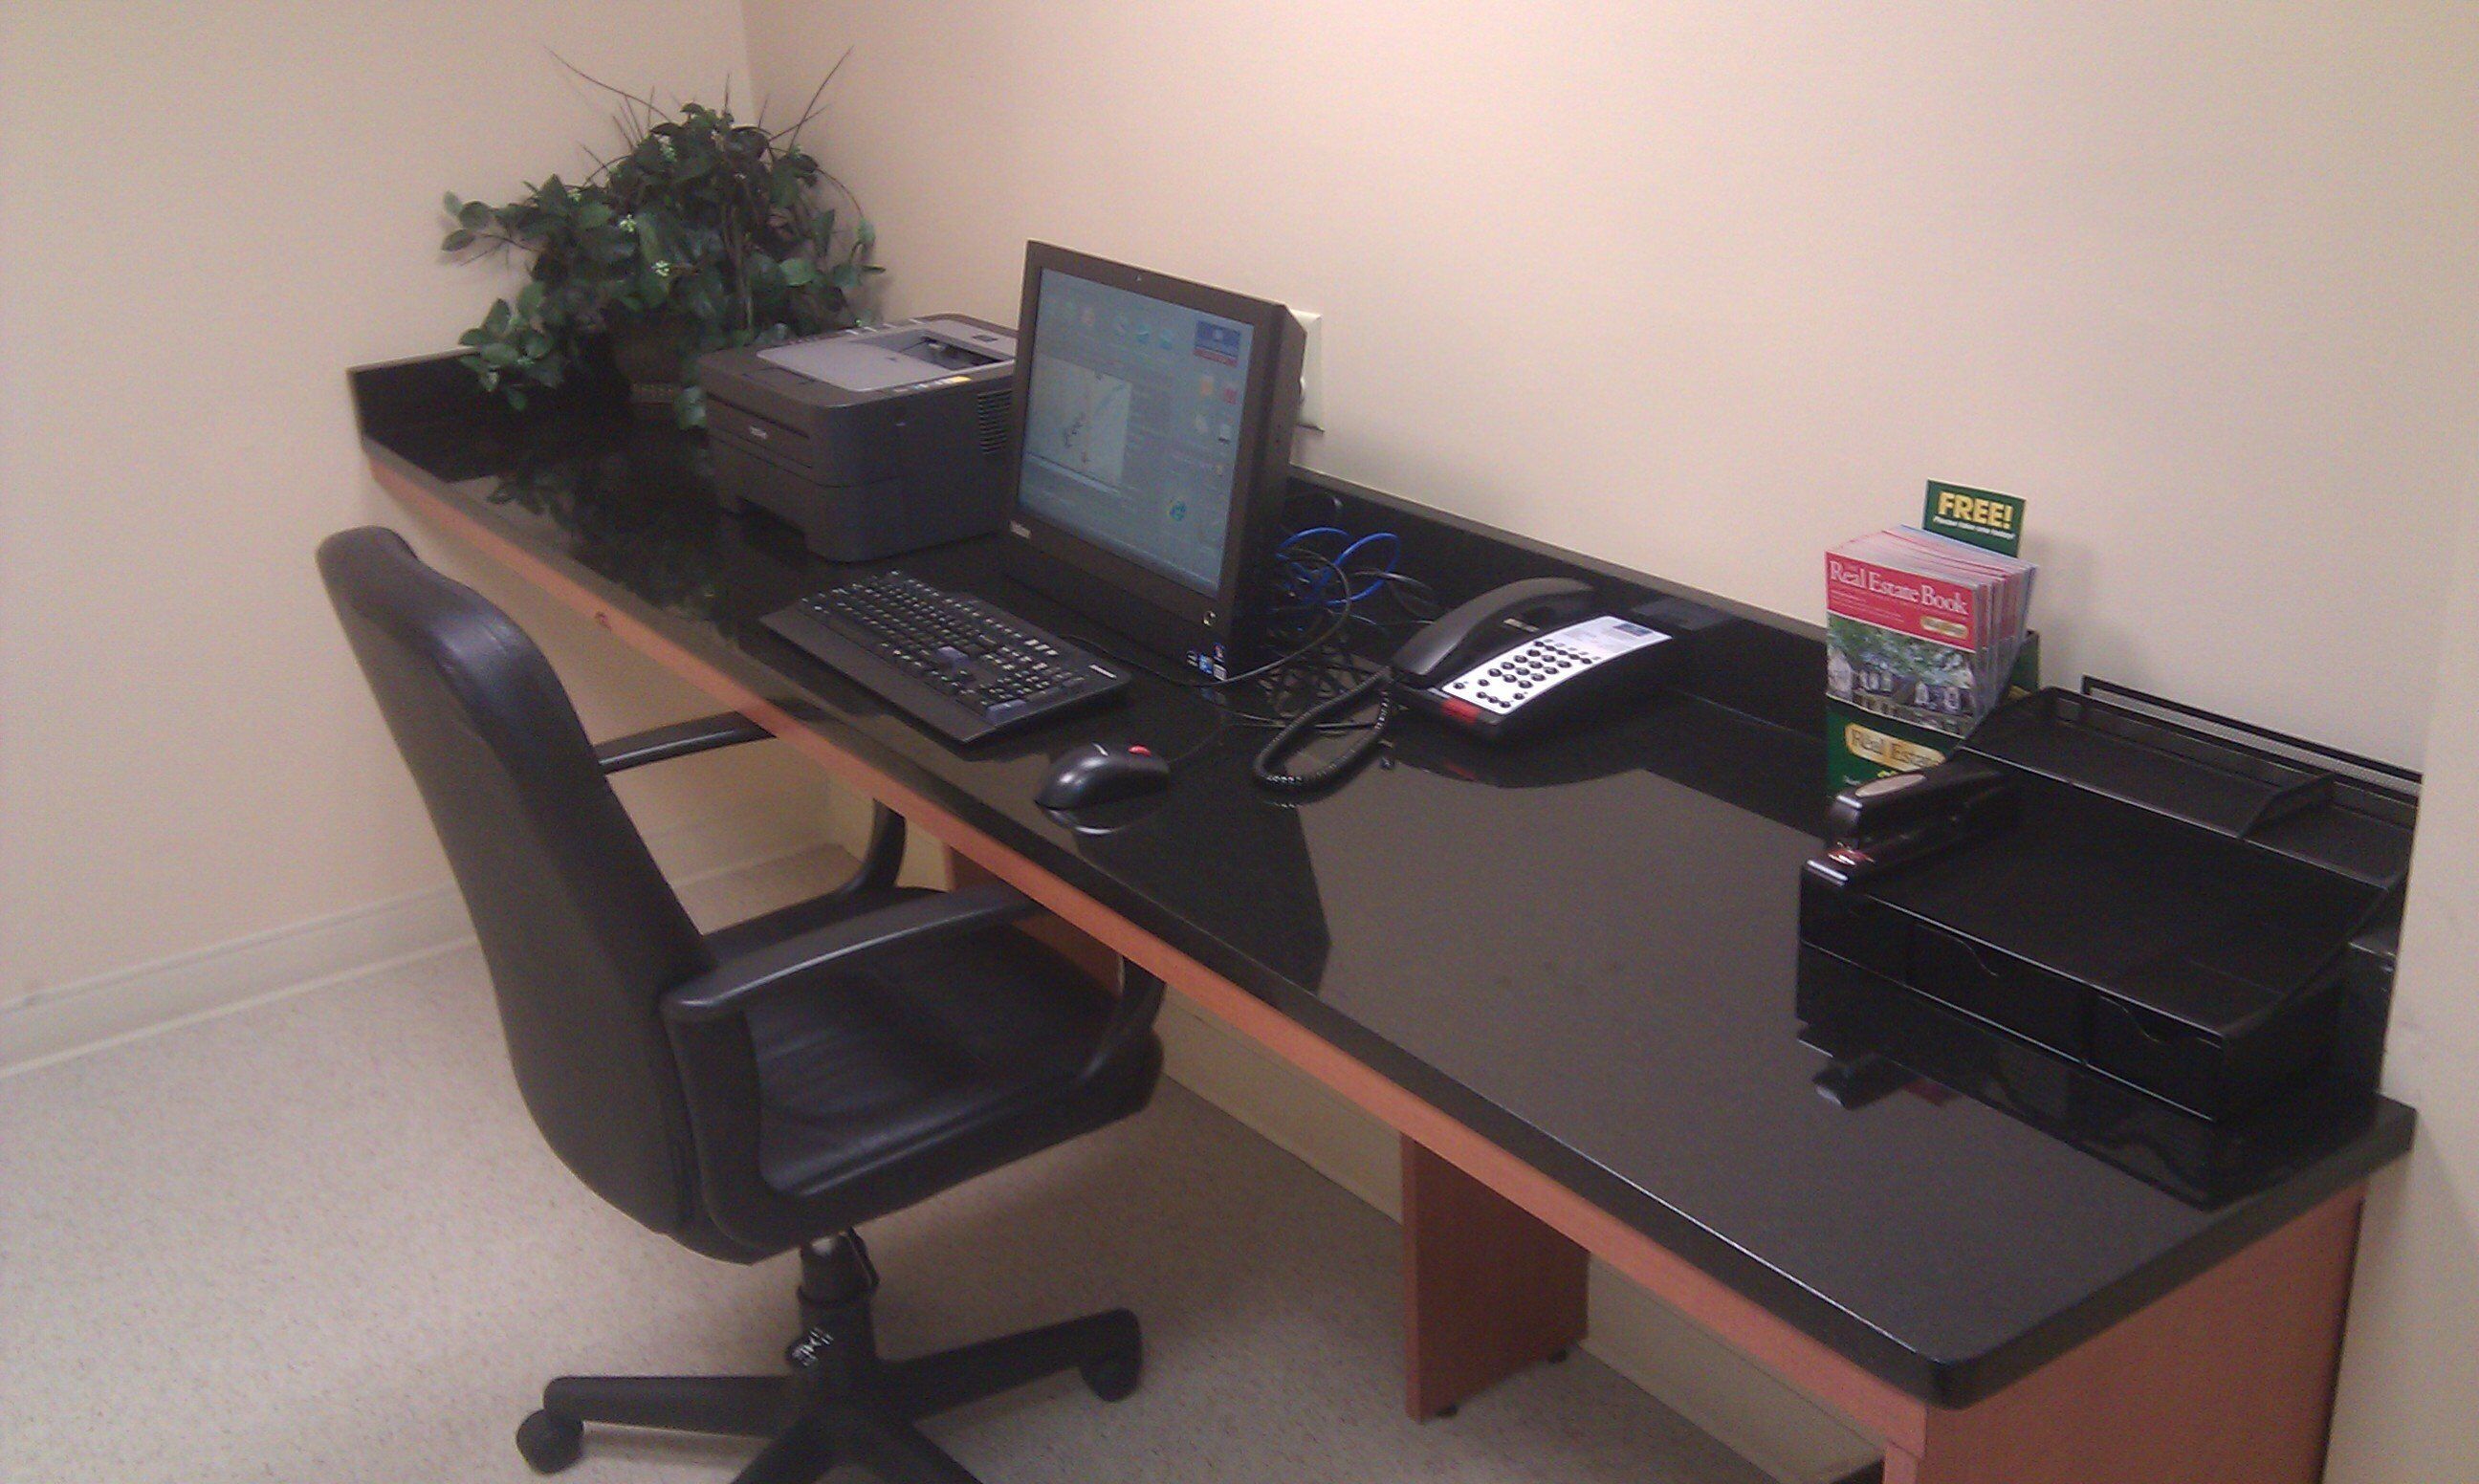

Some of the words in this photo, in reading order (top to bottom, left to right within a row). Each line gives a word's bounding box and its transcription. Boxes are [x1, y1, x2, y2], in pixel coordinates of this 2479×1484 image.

[1938, 491, 2013, 530] FREE!
[1829, 560, 1867, 589] Real
[1868, 571, 1919, 602] Estate
[1920, 584, 1968, 615] Book
